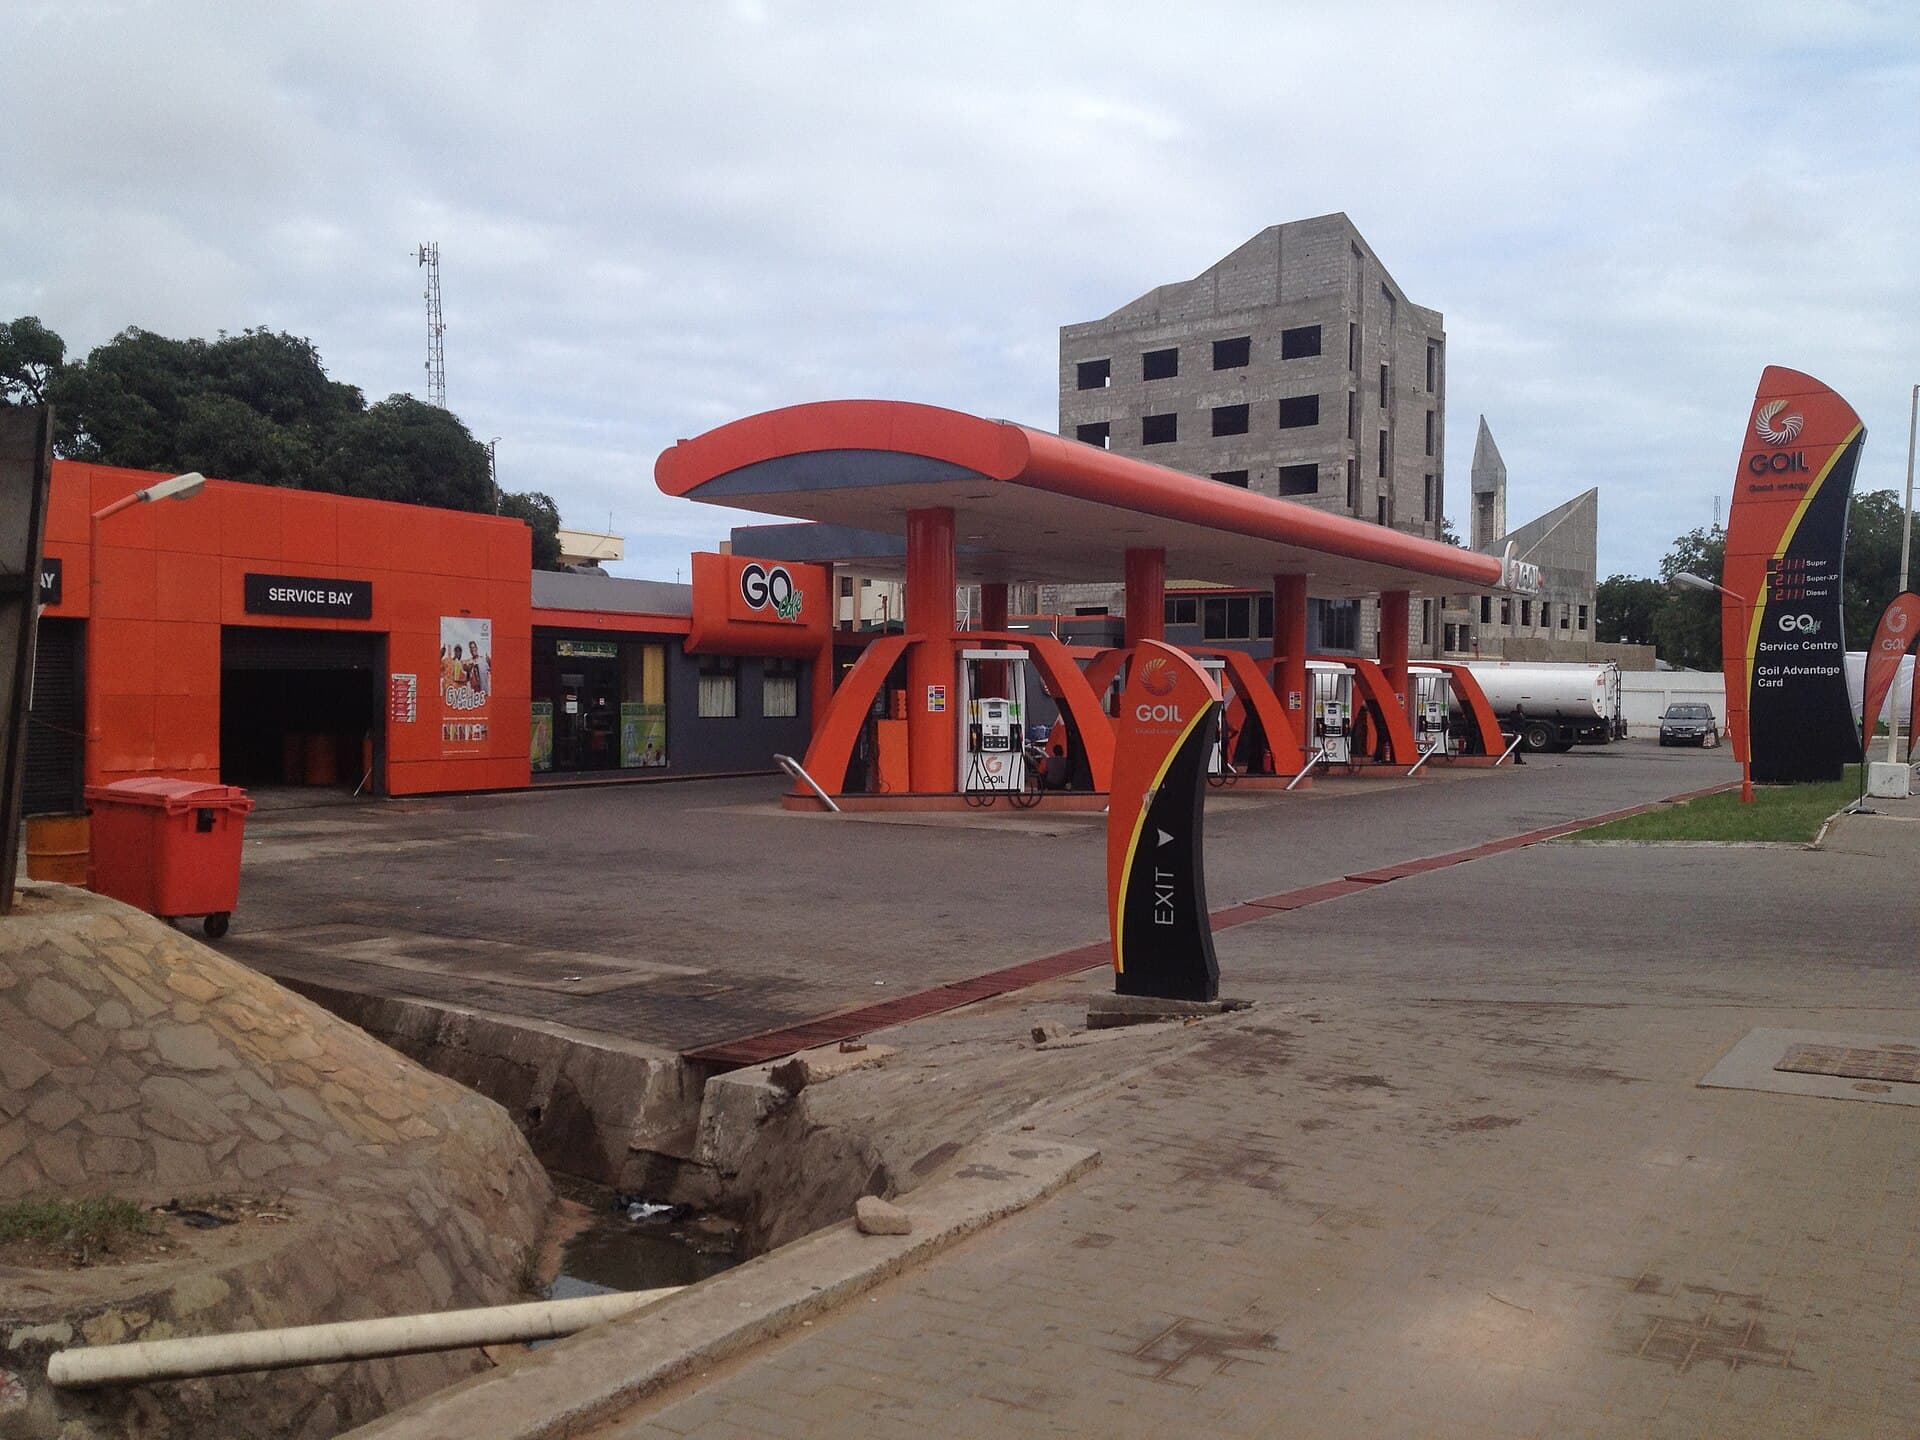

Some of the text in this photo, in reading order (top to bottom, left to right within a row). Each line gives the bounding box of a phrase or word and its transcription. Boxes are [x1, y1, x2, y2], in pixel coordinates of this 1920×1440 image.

[1749, 451, 1810, 476] GOIL
[741, 562, 793, 611] GO
[268, 587, 353, 605] SERVICE BAY
[1778, 614, 1814, 632] GO
[1759, 641, 1839, 652] Service Centre
[1758, 666, 1840, 676] Goil Advantage
[1758, 678, 1784, 688] Card
[1135, 704, 1183, 722] GOIL
[1154, 866, 1174, 925] EXIT
